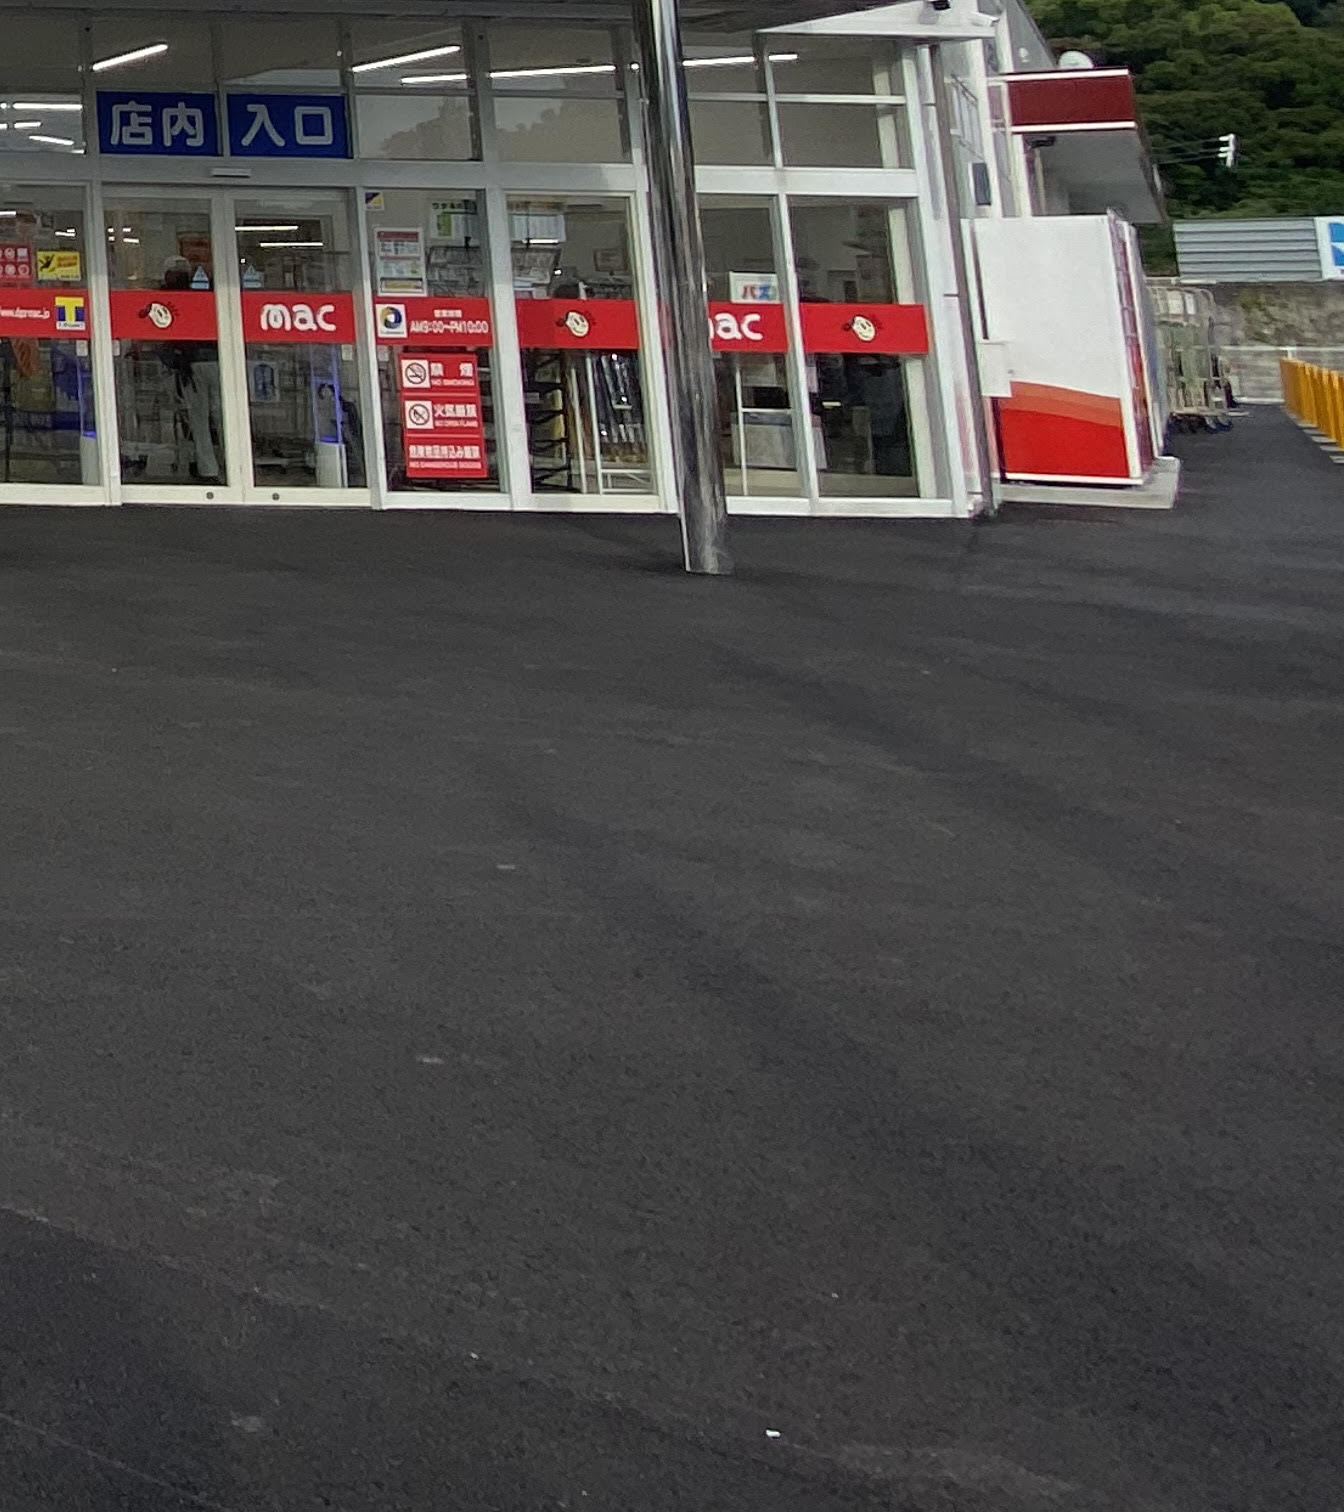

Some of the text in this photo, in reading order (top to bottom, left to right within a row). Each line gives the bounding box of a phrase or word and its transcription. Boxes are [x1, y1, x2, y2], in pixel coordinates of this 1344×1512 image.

[111, 101, 334, 148] 店内 入口
[260, 303, 337, 332] mac
[708, 312, 764, 341] ac
